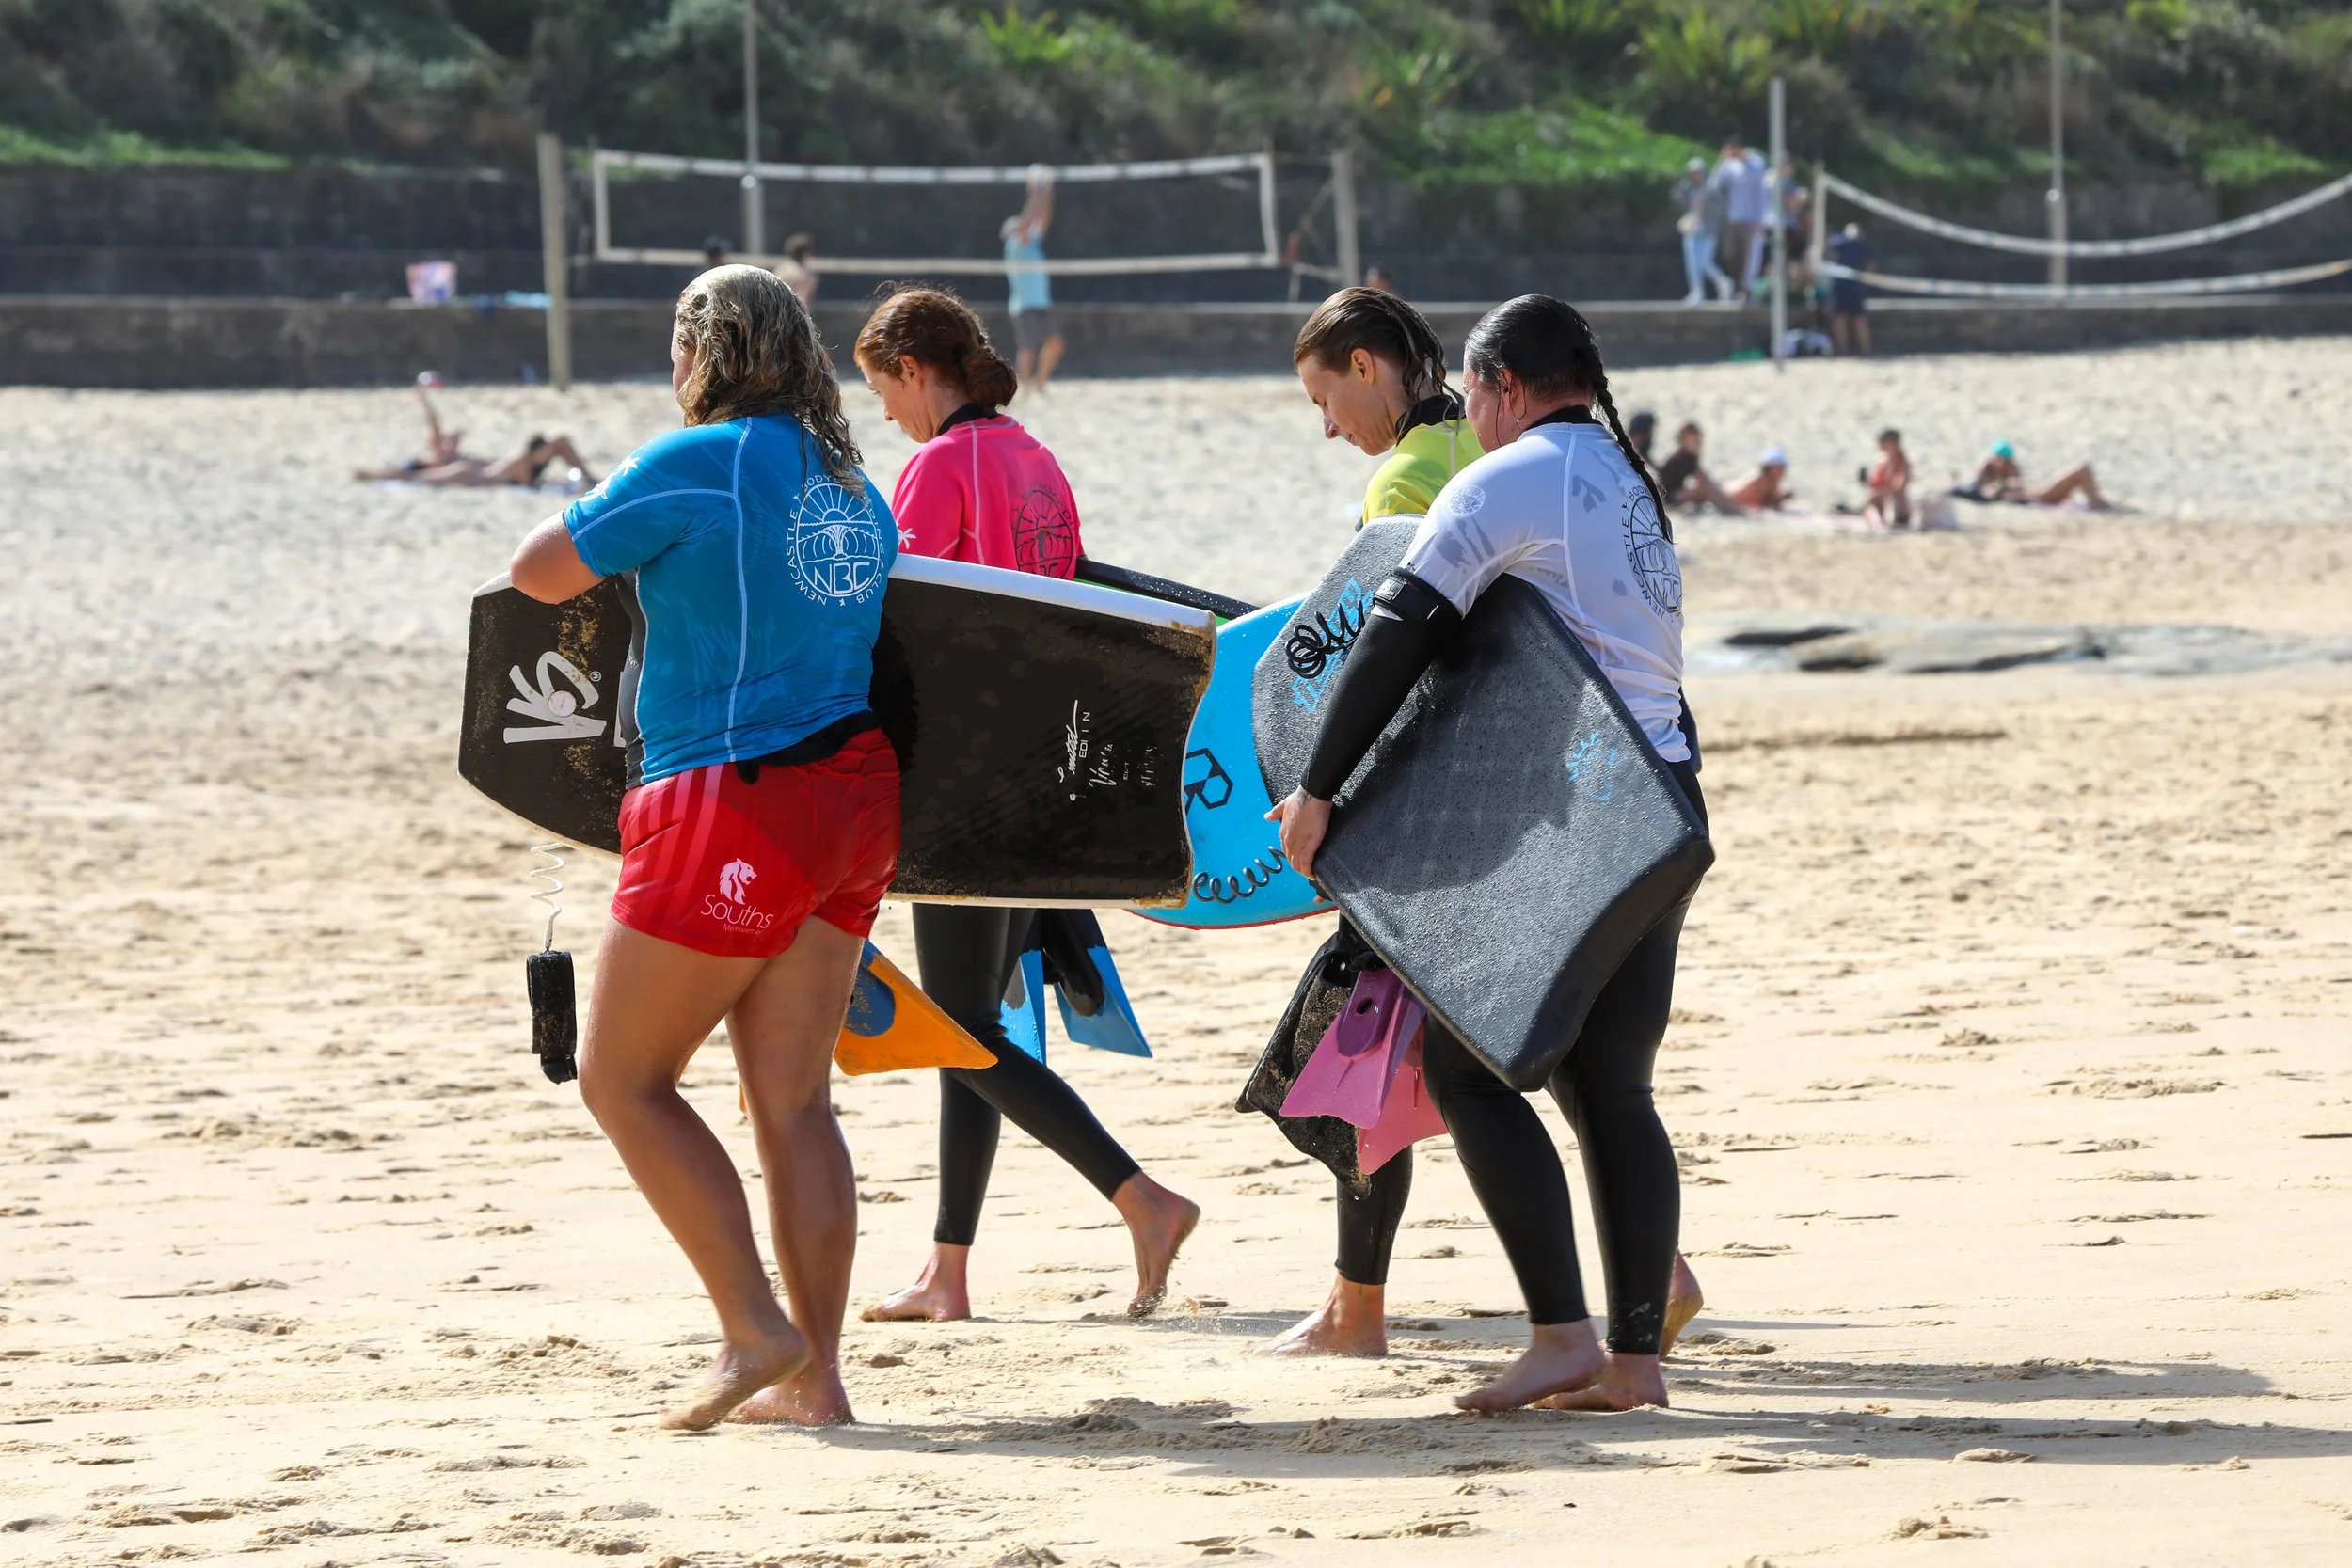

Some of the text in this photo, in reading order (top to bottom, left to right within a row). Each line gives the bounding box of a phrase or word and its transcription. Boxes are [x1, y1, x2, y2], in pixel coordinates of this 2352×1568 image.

[787, 511, 827, 605] NEWCASTLE
[857, 573, 882, 604] CLUB
[814, 562, 870, 594] NBC
[1078, 711, 1090, 758] EDIIN
[700, 894, 774, 929] Souths
